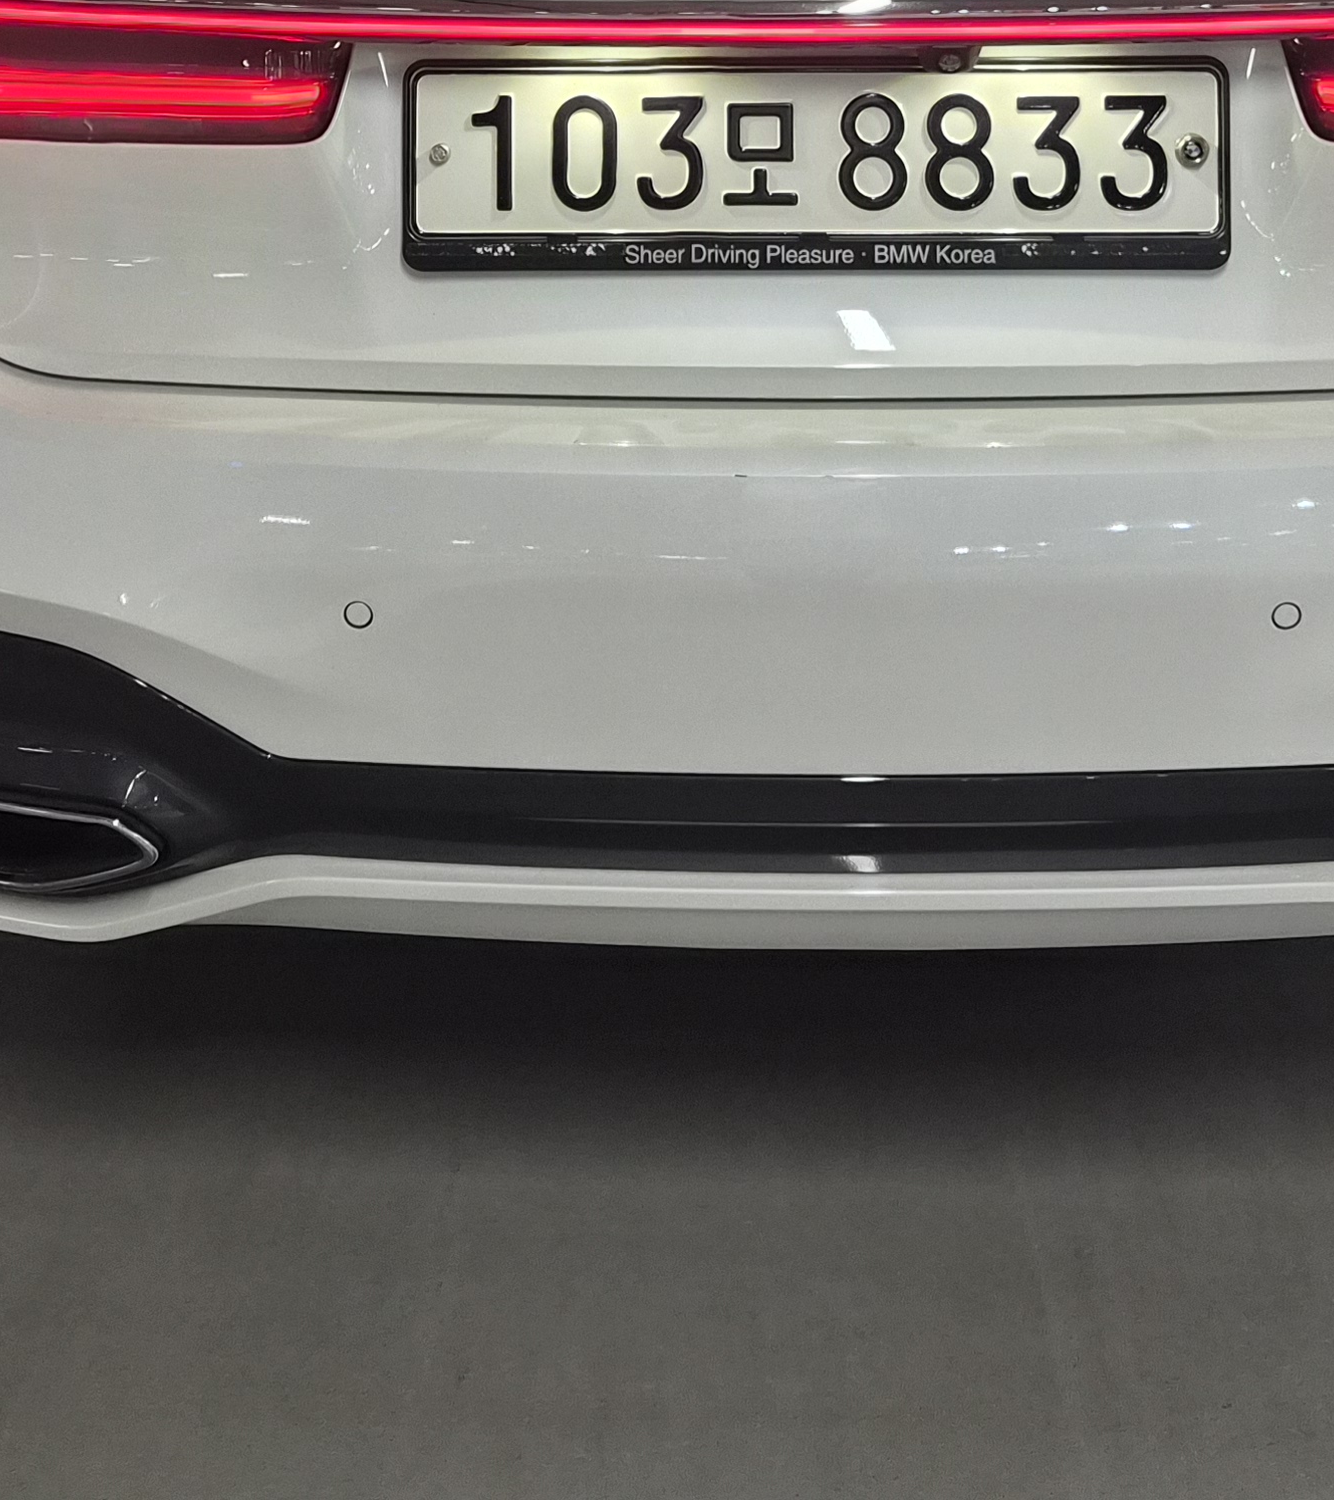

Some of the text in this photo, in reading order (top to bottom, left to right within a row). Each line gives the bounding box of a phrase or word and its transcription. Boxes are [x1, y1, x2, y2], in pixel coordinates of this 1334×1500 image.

[471, 93, 1170, 212] 103모 8833
[624, 243, 997, 269] Sheer Driving Pleasure BMW Korea
